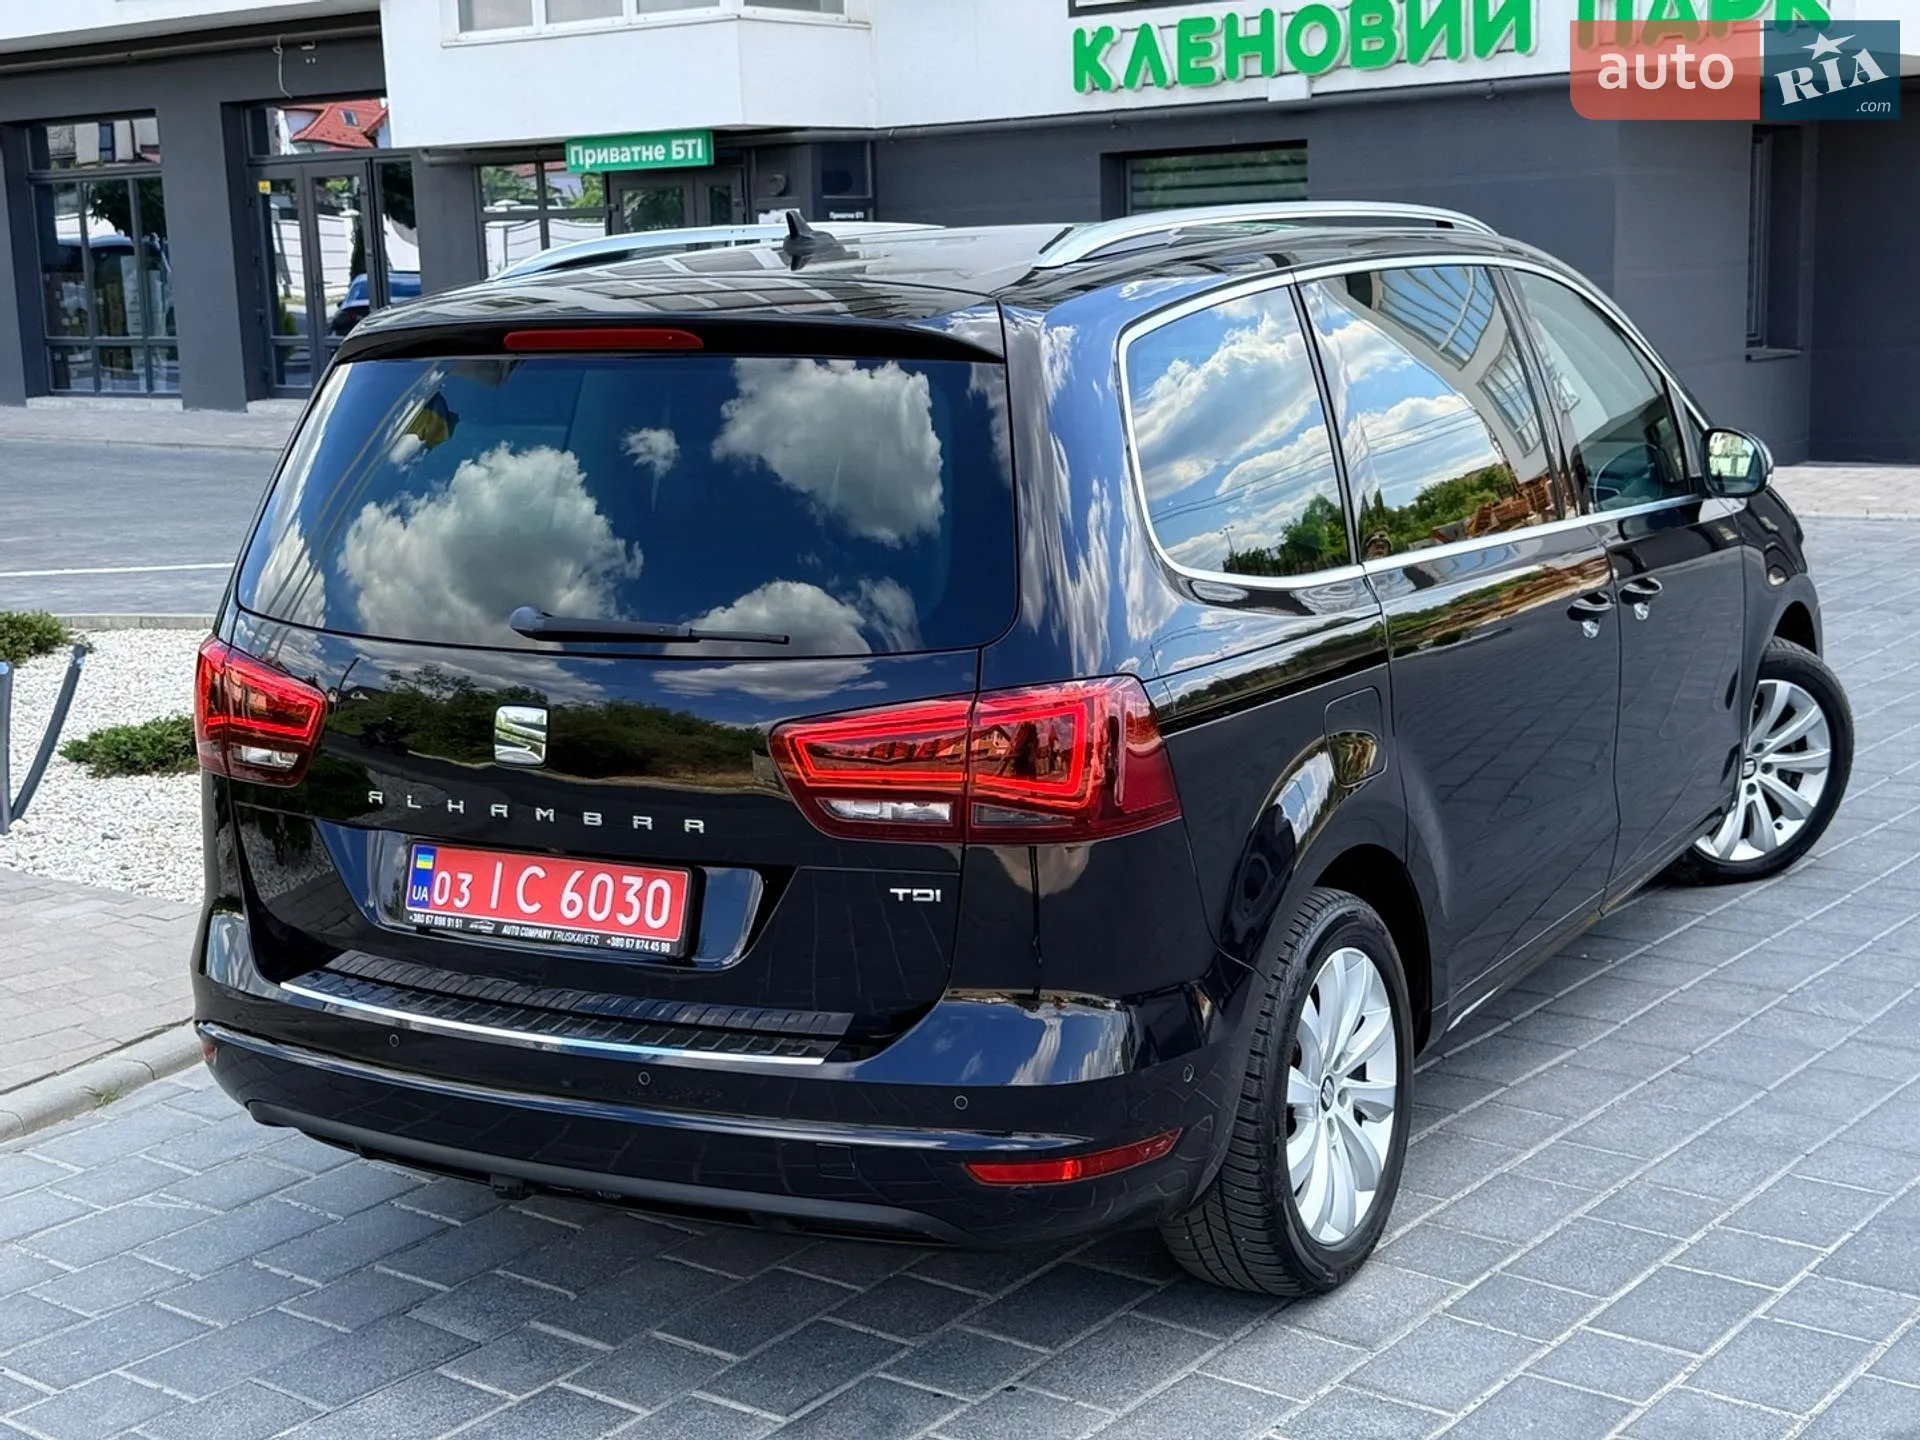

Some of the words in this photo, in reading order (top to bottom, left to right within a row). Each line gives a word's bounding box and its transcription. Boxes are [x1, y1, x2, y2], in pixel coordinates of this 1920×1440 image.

[570, 144, 666, 170] Приватне
[671, 138, 703, 160] БТІ
[368, 790, 705, 834] ALHAMBRA
[412, 885, 429, 902] UA
[433, 870, 474, 908] 03
[559, 869, 672, 930] 6030
[889, 887, 942, 902] TDI
[501, 924, 520, 936] AUTO
[520, 926, 552, 939] COMPANY
[552, 930, 600, 946] TRUSKAVETS
